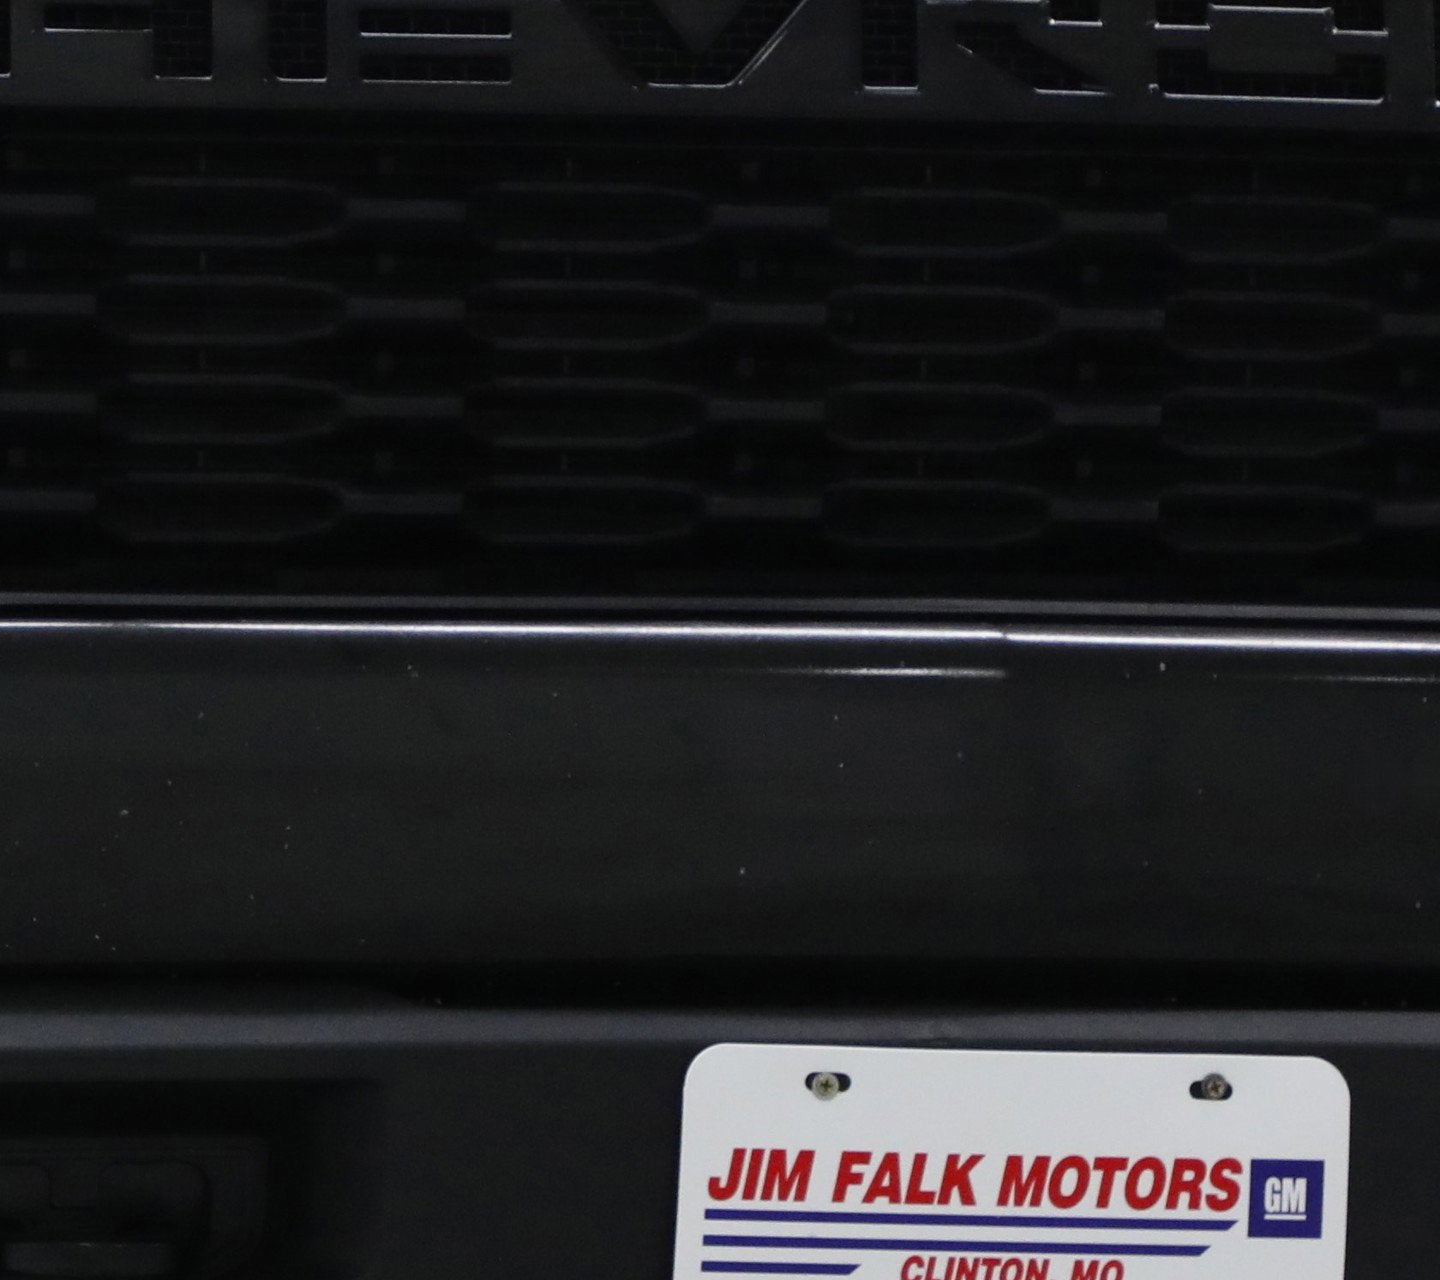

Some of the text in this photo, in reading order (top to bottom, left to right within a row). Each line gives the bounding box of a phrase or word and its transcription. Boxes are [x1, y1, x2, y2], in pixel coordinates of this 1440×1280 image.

[707, 1147, 1243, 1213] JIM FALK MOTORS
[1263, 1175, 1308, 1214] GM
